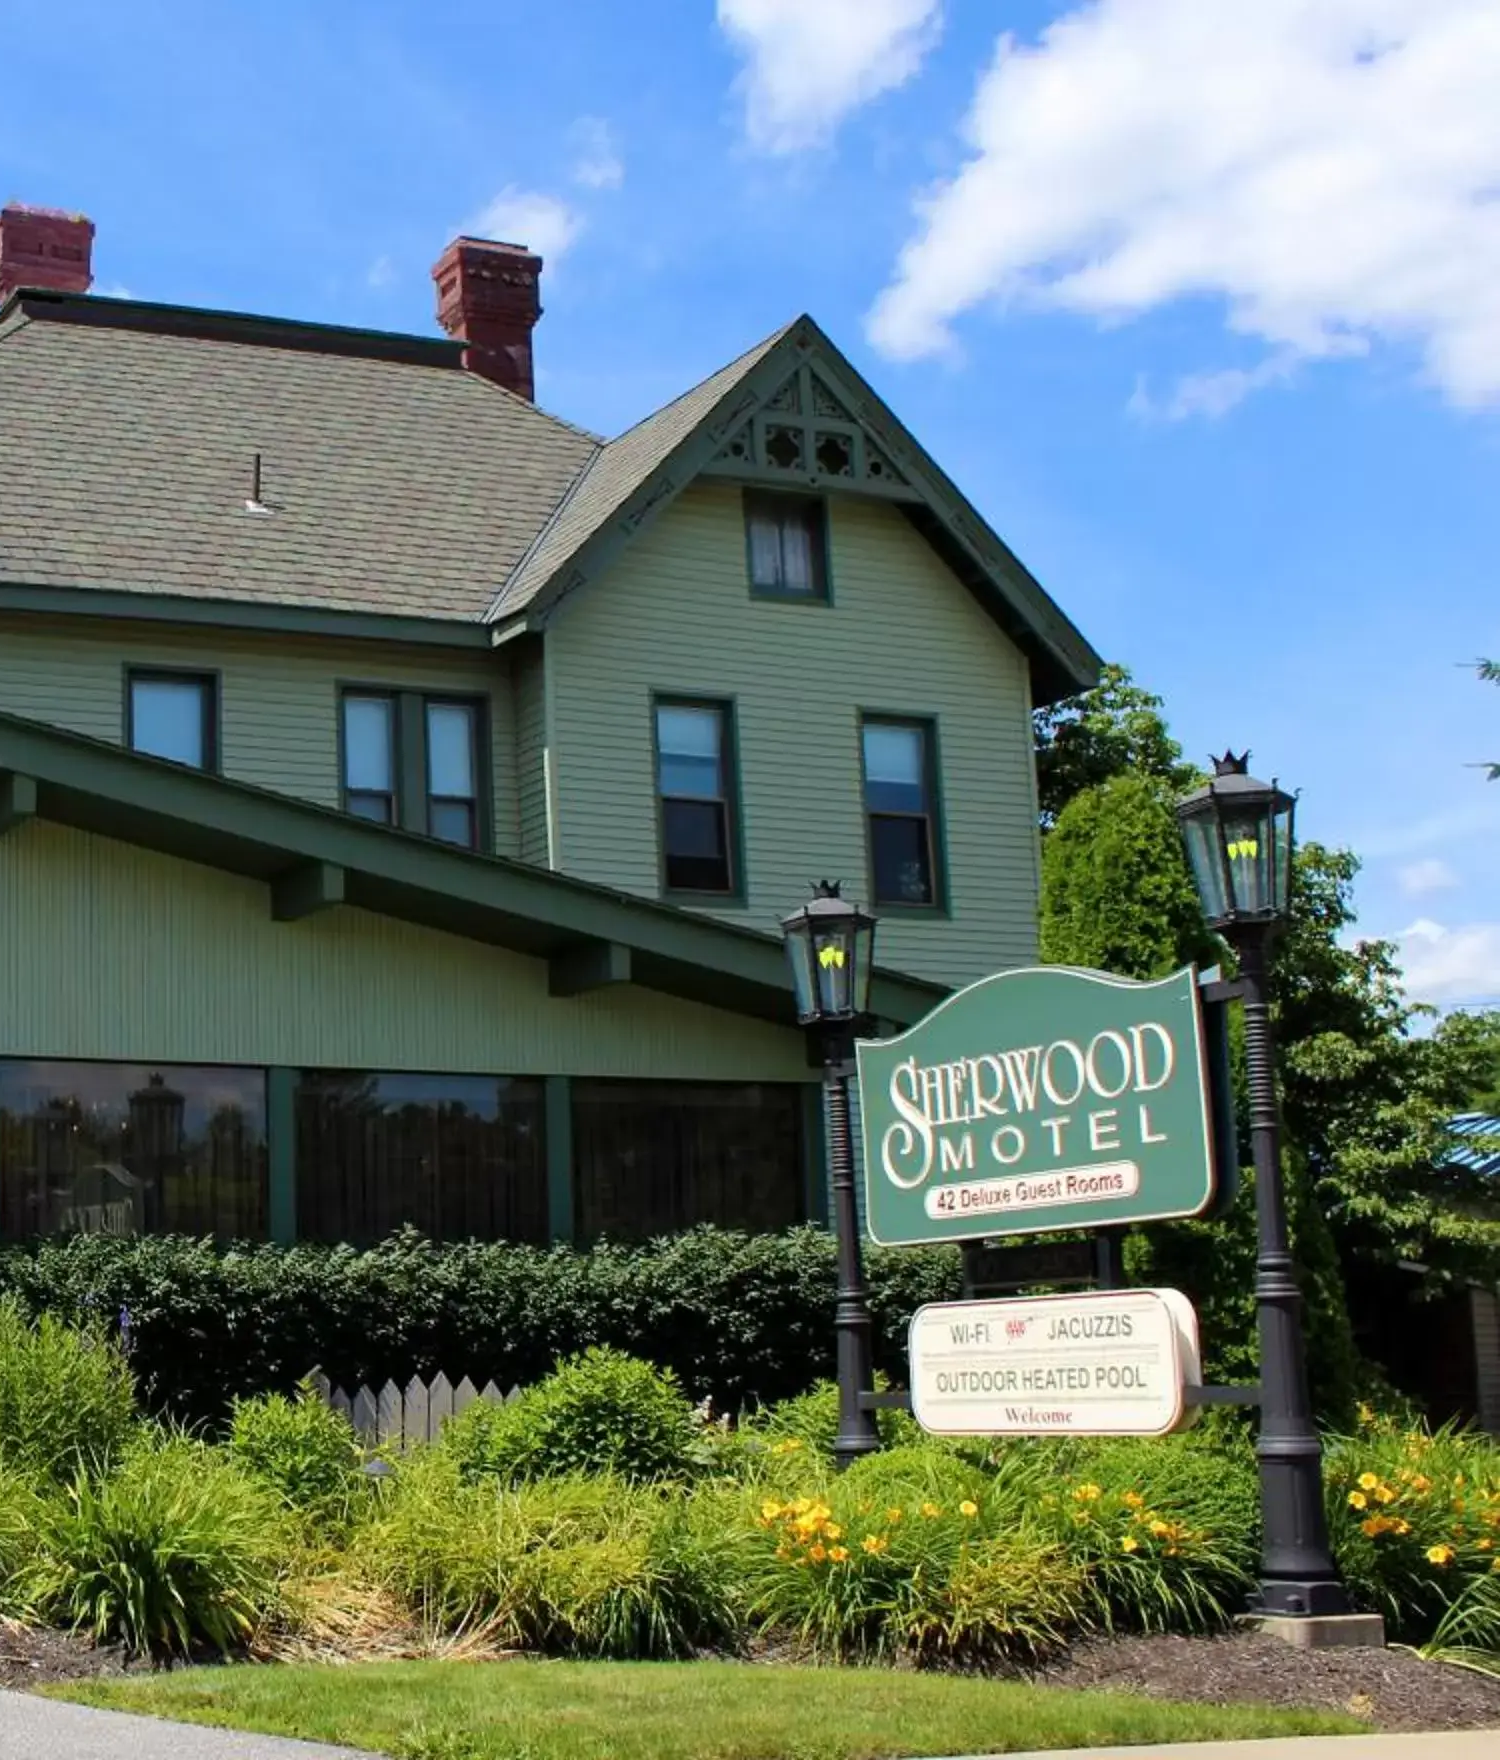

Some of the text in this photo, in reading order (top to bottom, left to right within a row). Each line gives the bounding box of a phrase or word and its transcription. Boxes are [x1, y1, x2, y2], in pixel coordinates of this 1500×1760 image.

[881, 1022, 1175, 1189] SHERWOOD
[939, 1104, 1168, 1172] MOTEL
[937, 1171, 1124, 1211] 42 Deluxe Guest Rooms
[950, 1322, 991, 1345] WI-FI
[1047, 1314, 1133, 1341] JACUZZIS
[936, 1365, 1148, 1393] OUTDOOR HEATED POOL
[1005, 1407, 1073, 1425] Welcome
